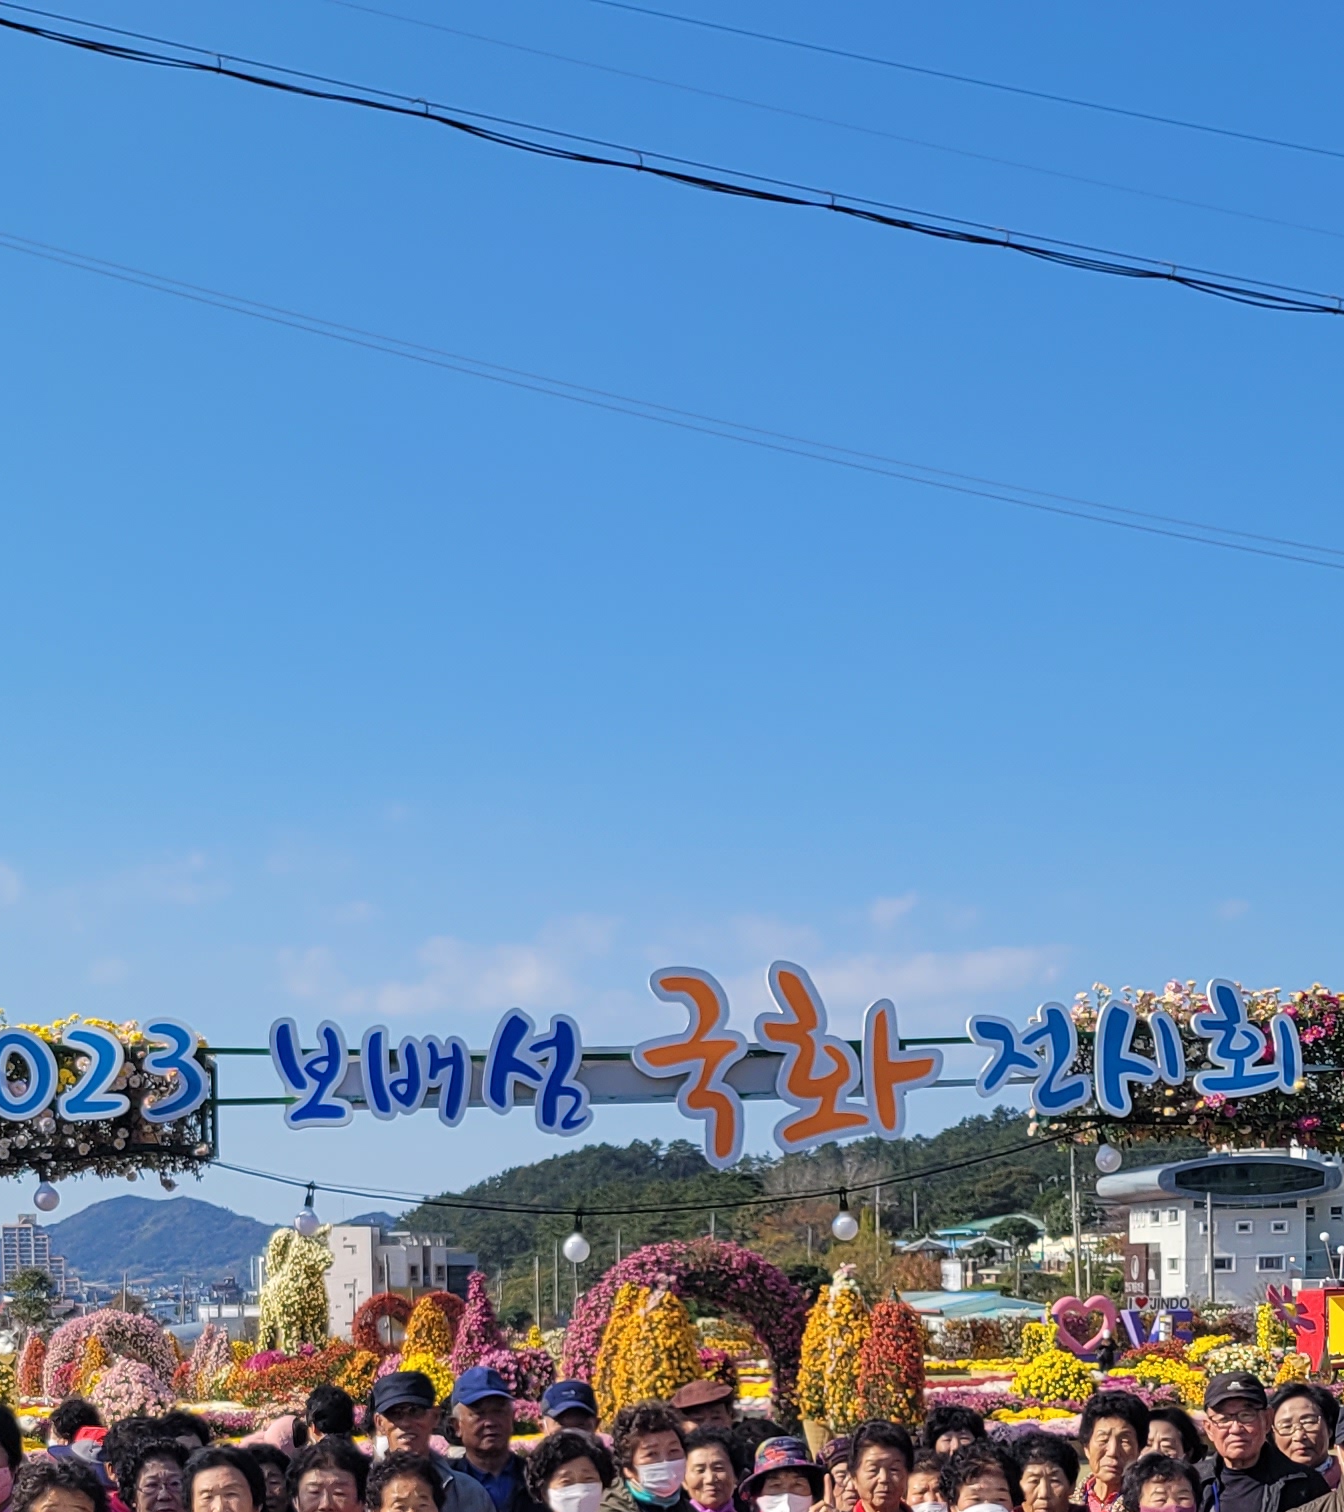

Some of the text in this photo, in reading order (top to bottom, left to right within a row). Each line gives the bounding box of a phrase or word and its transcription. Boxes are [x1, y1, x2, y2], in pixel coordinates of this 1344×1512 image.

[272, 1010, 592, 1134] 보배섬
[637, 964, 940, 1166] 국화
[970, 980, 1302, 1114] 전시회
[1149, 1297, 1190, 1310] JINDO
